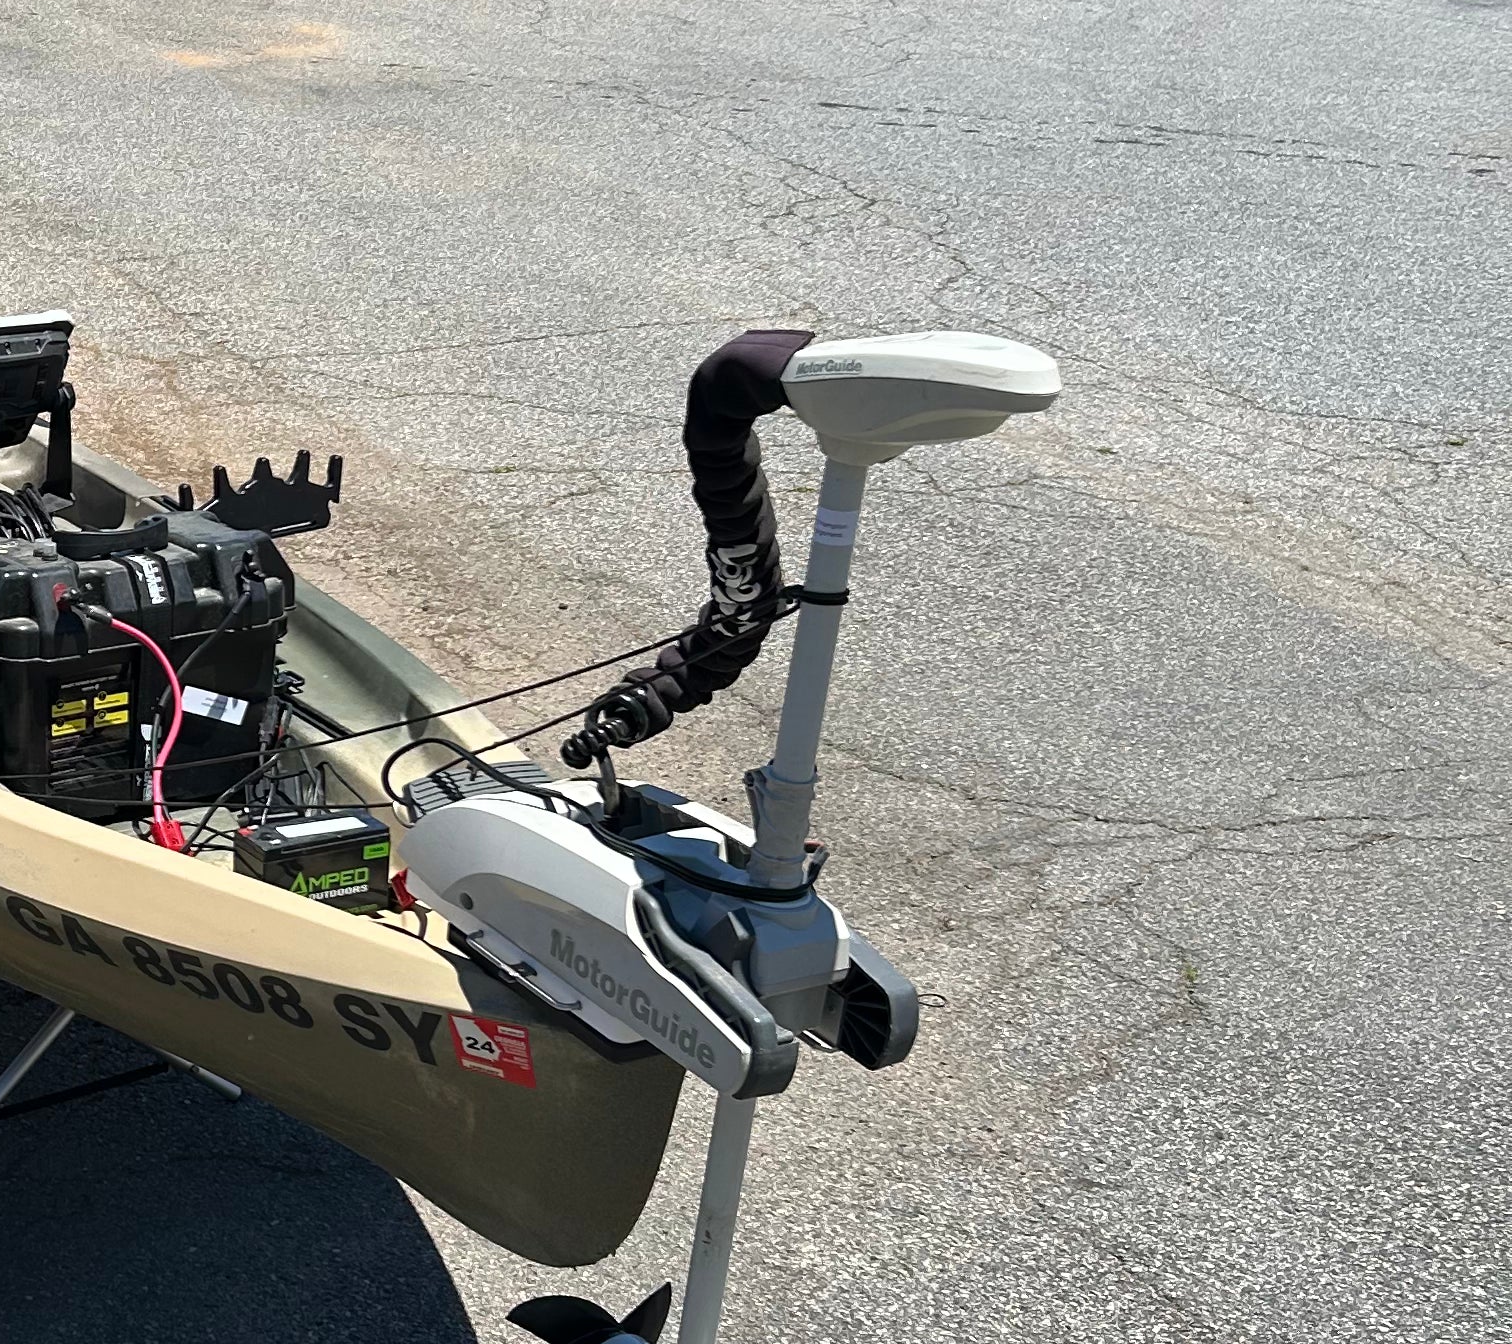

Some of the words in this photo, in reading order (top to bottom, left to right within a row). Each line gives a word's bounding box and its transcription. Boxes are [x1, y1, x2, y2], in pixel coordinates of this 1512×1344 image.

[795, 359, 863, 375] MotorGuide
[291, 867, 370, 894] AMPED
[5, 895, 119, 968] GA
[121, 936, 314, 1029] 8508
[331, 992, 443, 1067] SY
[550, 928, 716, 1069] MotorGuide
[466, 1036, 496, 1055] 24
